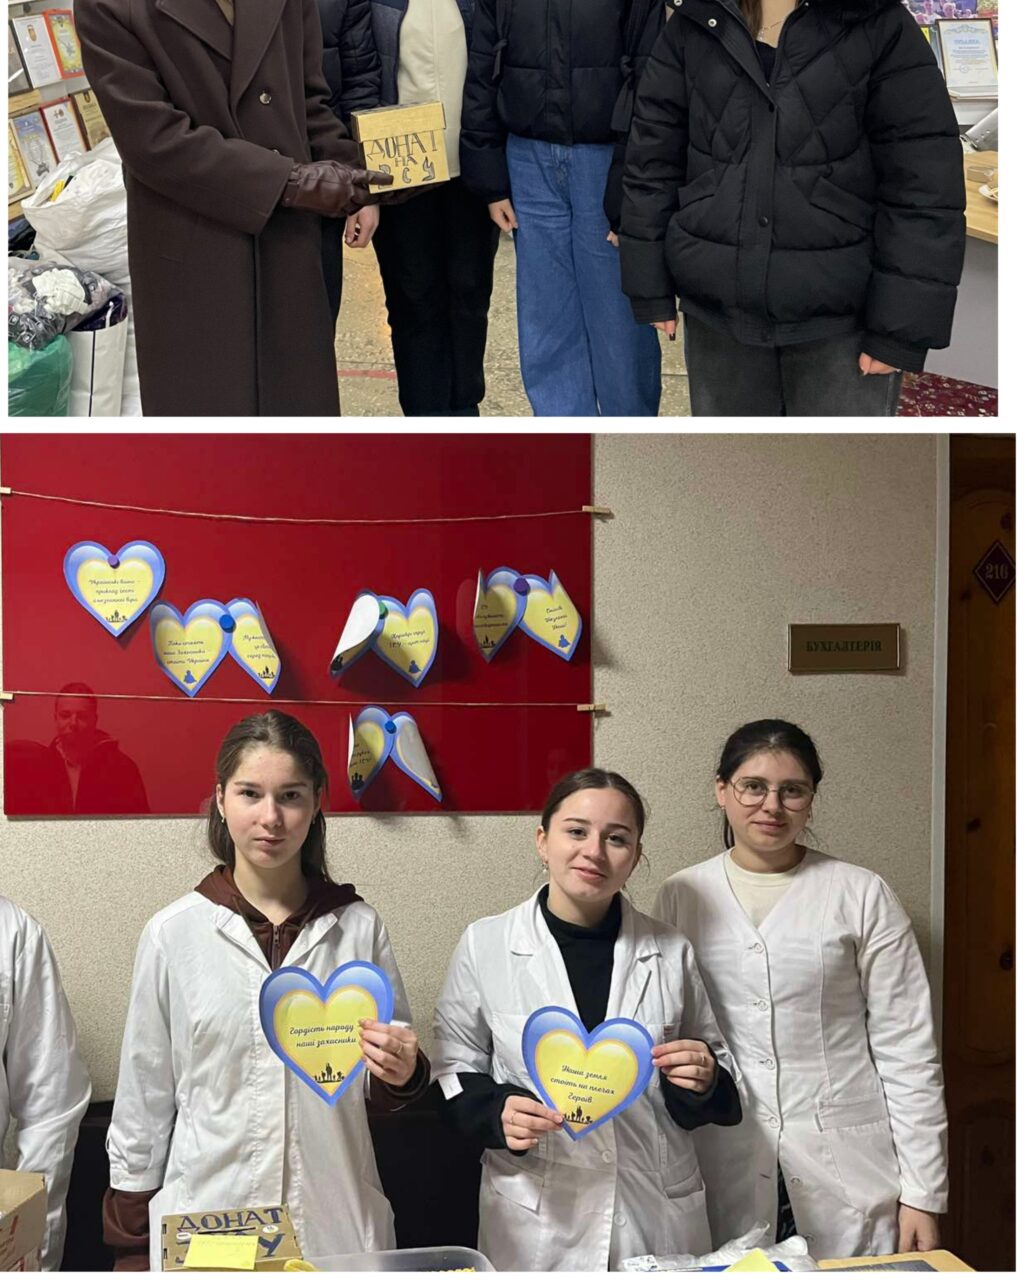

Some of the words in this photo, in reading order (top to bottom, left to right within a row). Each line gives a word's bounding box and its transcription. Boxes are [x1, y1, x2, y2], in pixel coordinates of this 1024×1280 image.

[805, 640, 883, 652] БУХГАЛТЕРІЯ
[289, 1026, 325, 1037] Гордість
[326, 1024, 354, 1032] народу
[316, 1037, 357, 1049] захисники
[561, 1064, 584, 1076] Наша
[584, 1071, 608, 1080] земля
[550, 1077, 577, 1088] стоїть
[578, 1082, 588, 1090] на
[589, 1084, 616, 1095] плечах
[568, 1091, 593, 1104] Героїв
[176, 1207, 284, 1232] ДОНАТ
